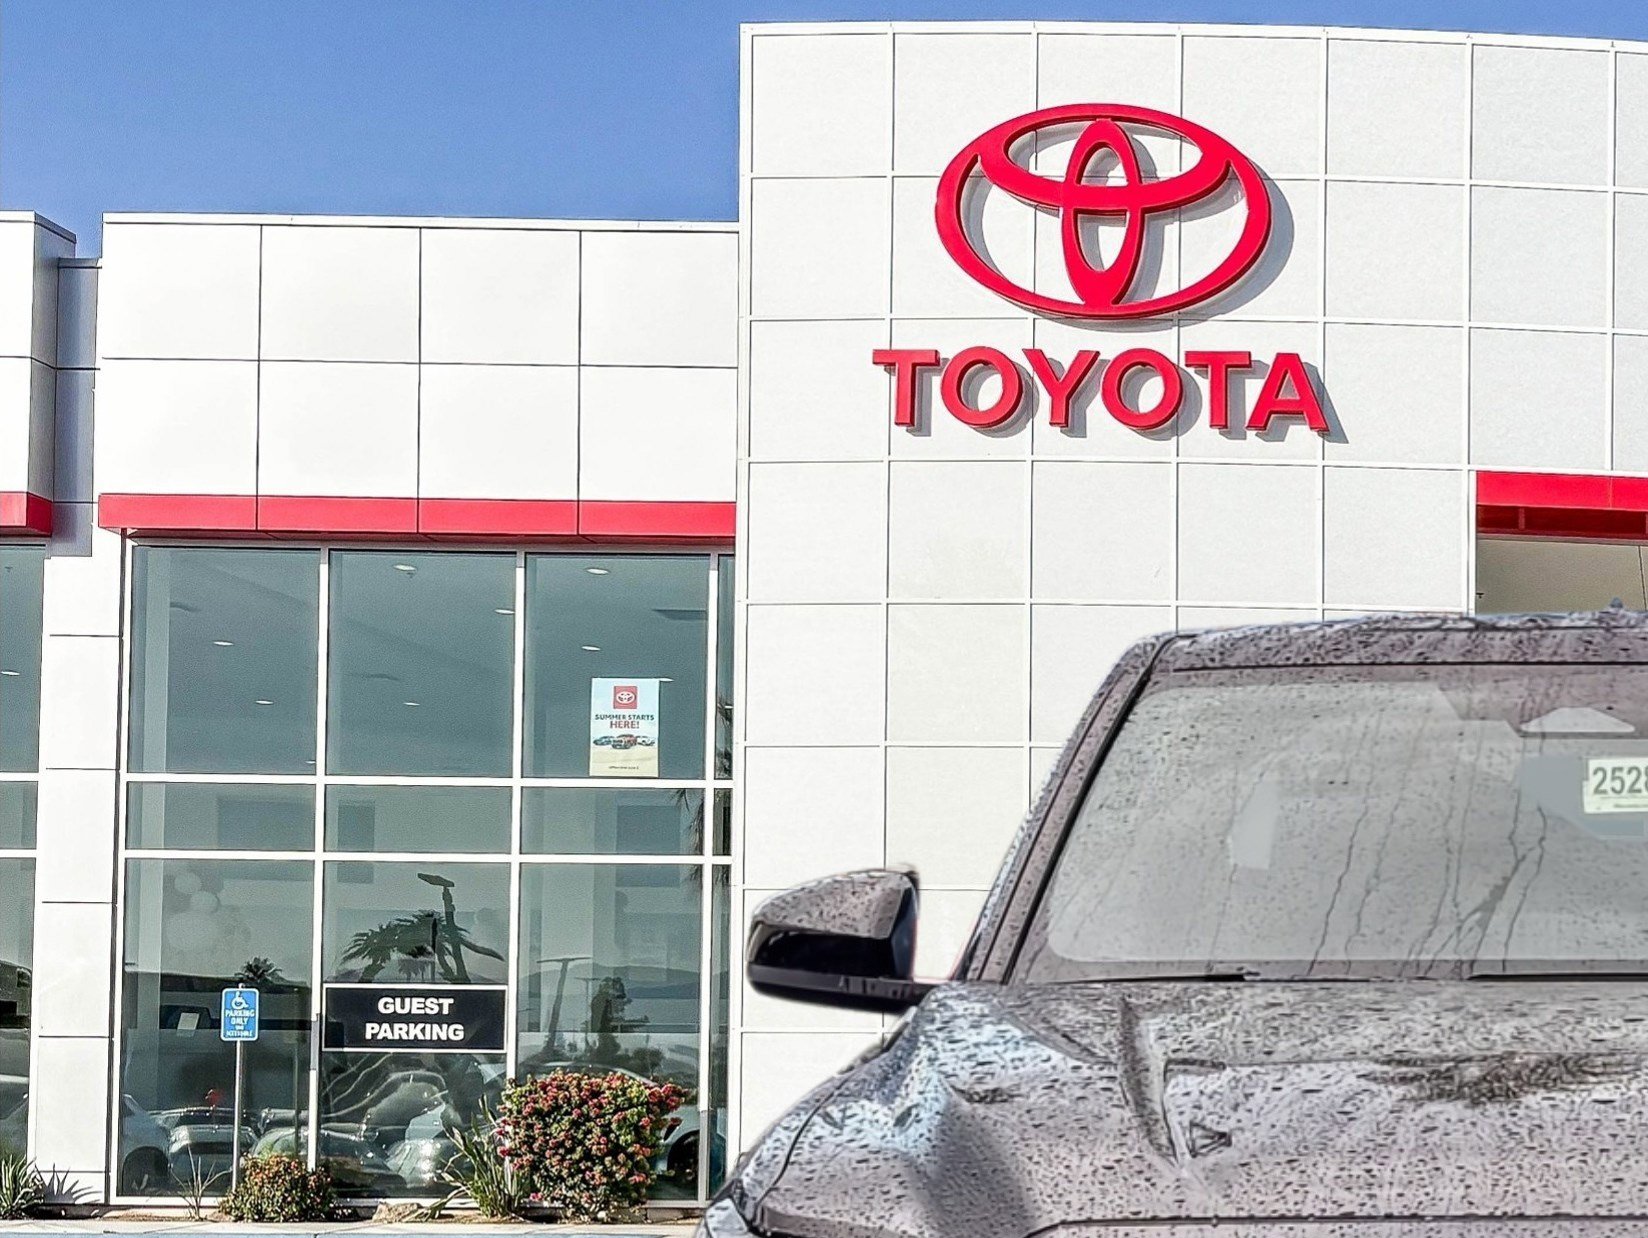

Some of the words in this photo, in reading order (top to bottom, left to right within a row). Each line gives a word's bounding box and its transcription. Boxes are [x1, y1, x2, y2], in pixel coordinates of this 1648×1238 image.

[872, 346, 1330, 433] TOYOTA
[609, 720, 640, 729] HERE!
[377, 996, 455, 1015] GUEST
[364, 1022, 465, 1041] PARKING
